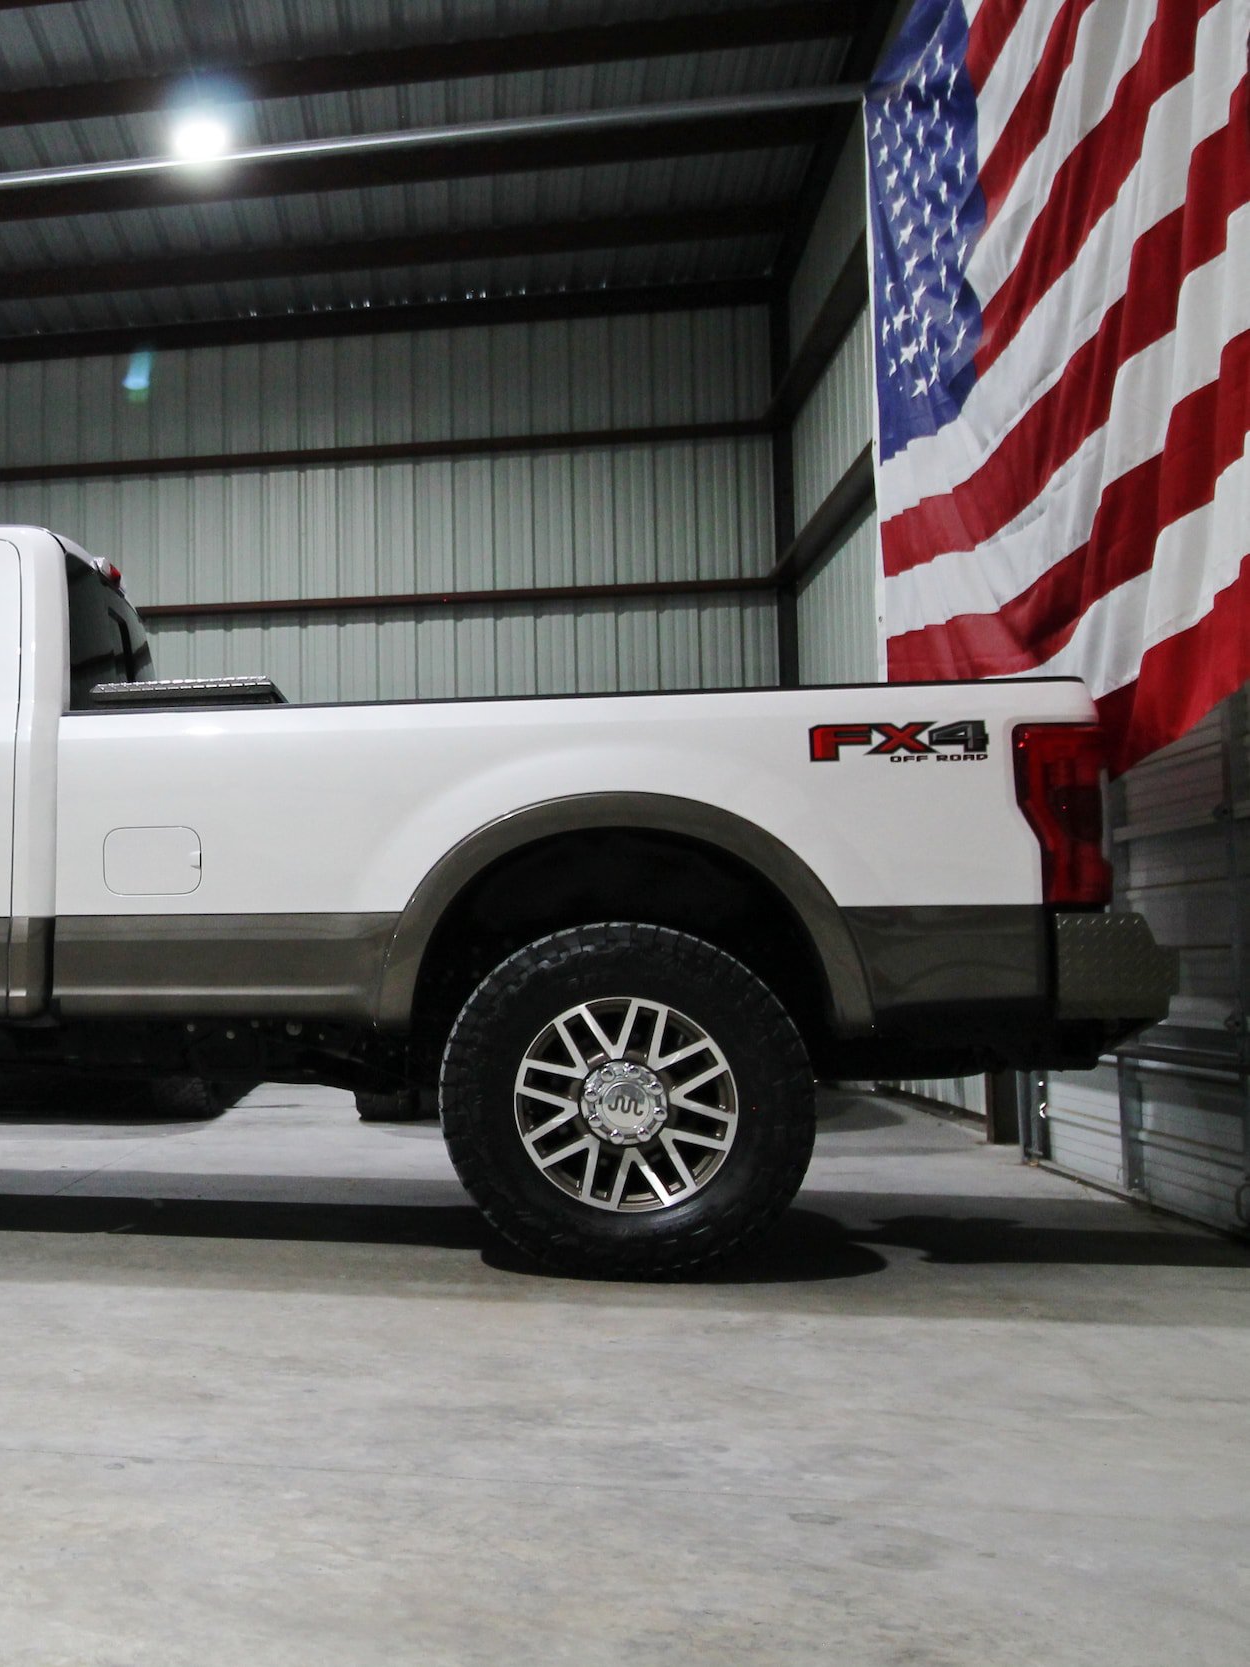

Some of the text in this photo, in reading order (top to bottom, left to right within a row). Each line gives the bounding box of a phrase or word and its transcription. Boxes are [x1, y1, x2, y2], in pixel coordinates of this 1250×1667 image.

[808, 719, 990, 763] FX4
[889, 753, 989, 763] OFF ROAD
